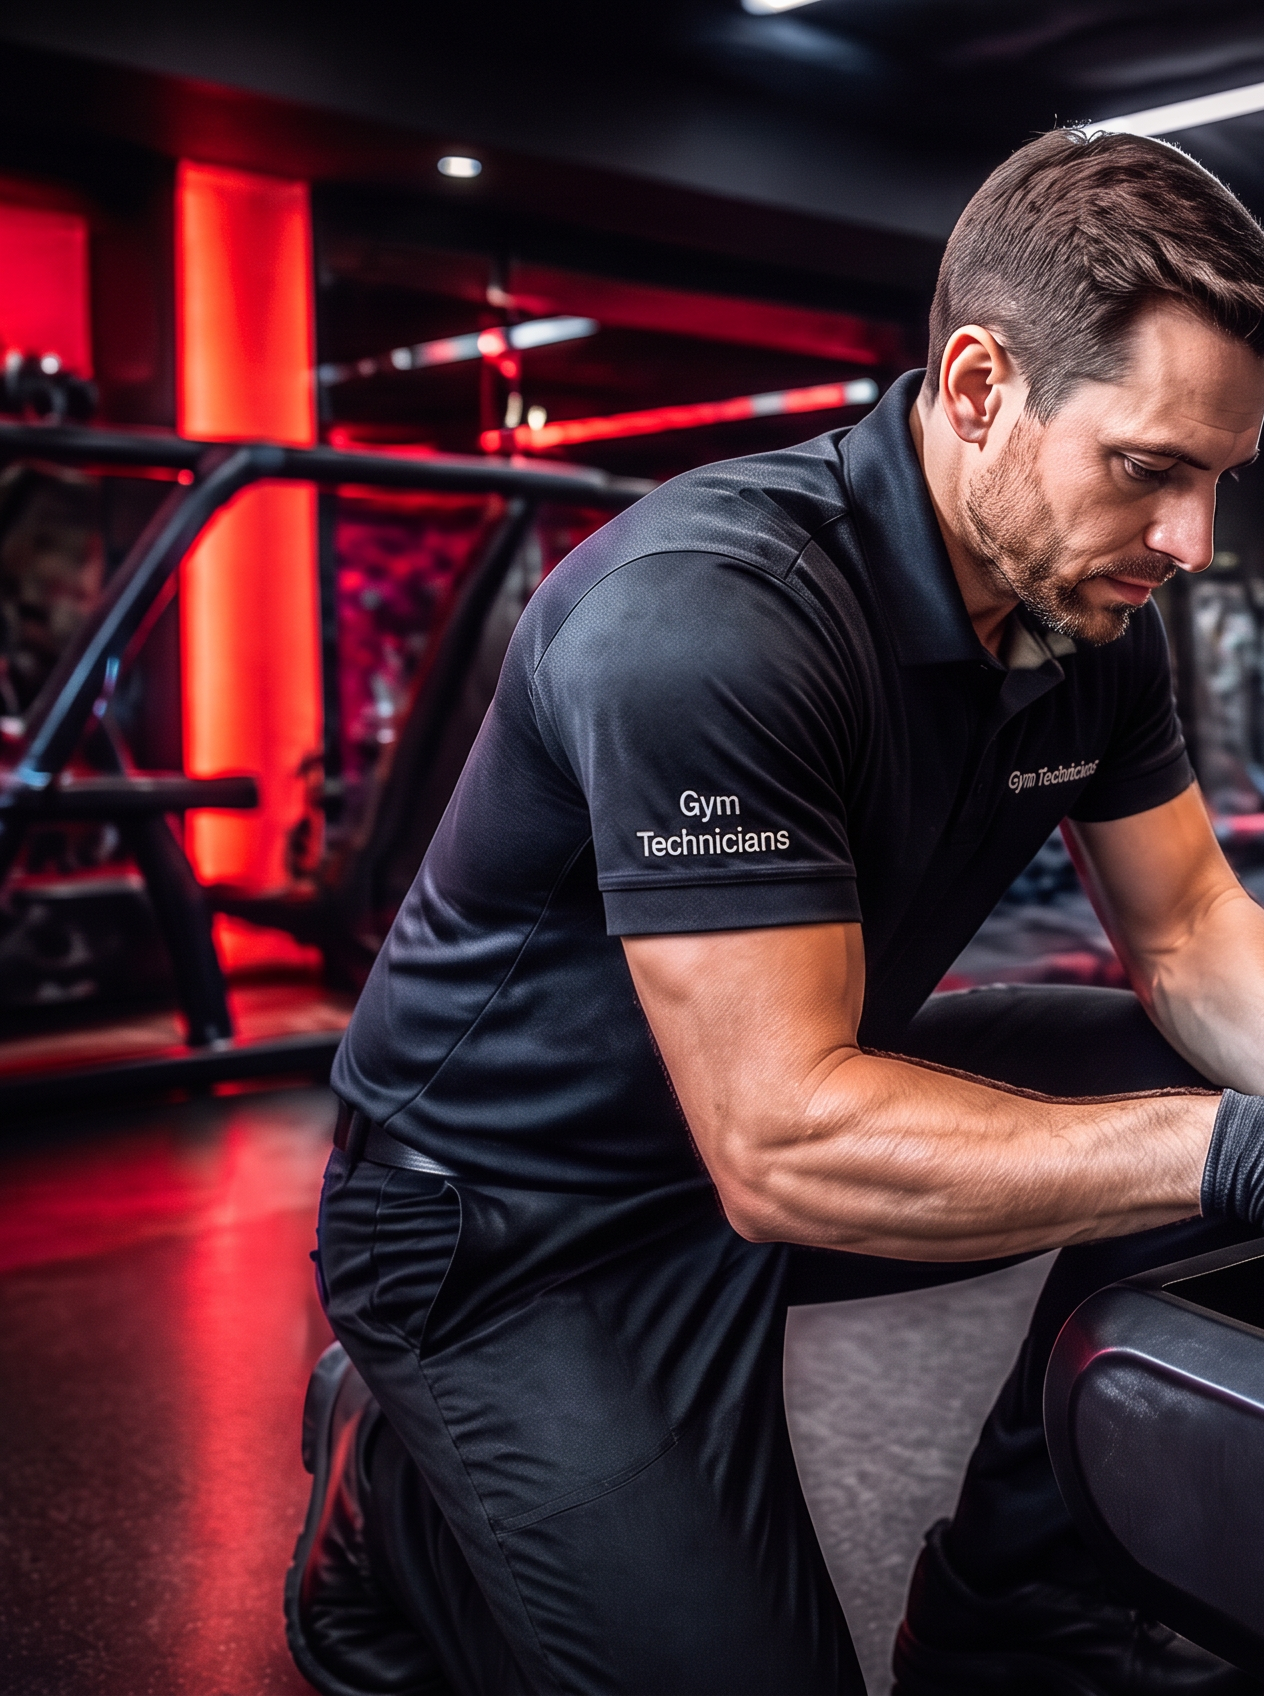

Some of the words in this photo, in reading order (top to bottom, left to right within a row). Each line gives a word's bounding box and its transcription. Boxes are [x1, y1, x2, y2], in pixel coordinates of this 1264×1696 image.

[1008, 770, 1037, 794] Gym
[679, 790, 740, 823] Gym
[636, 826, 790, 857] Technicians
